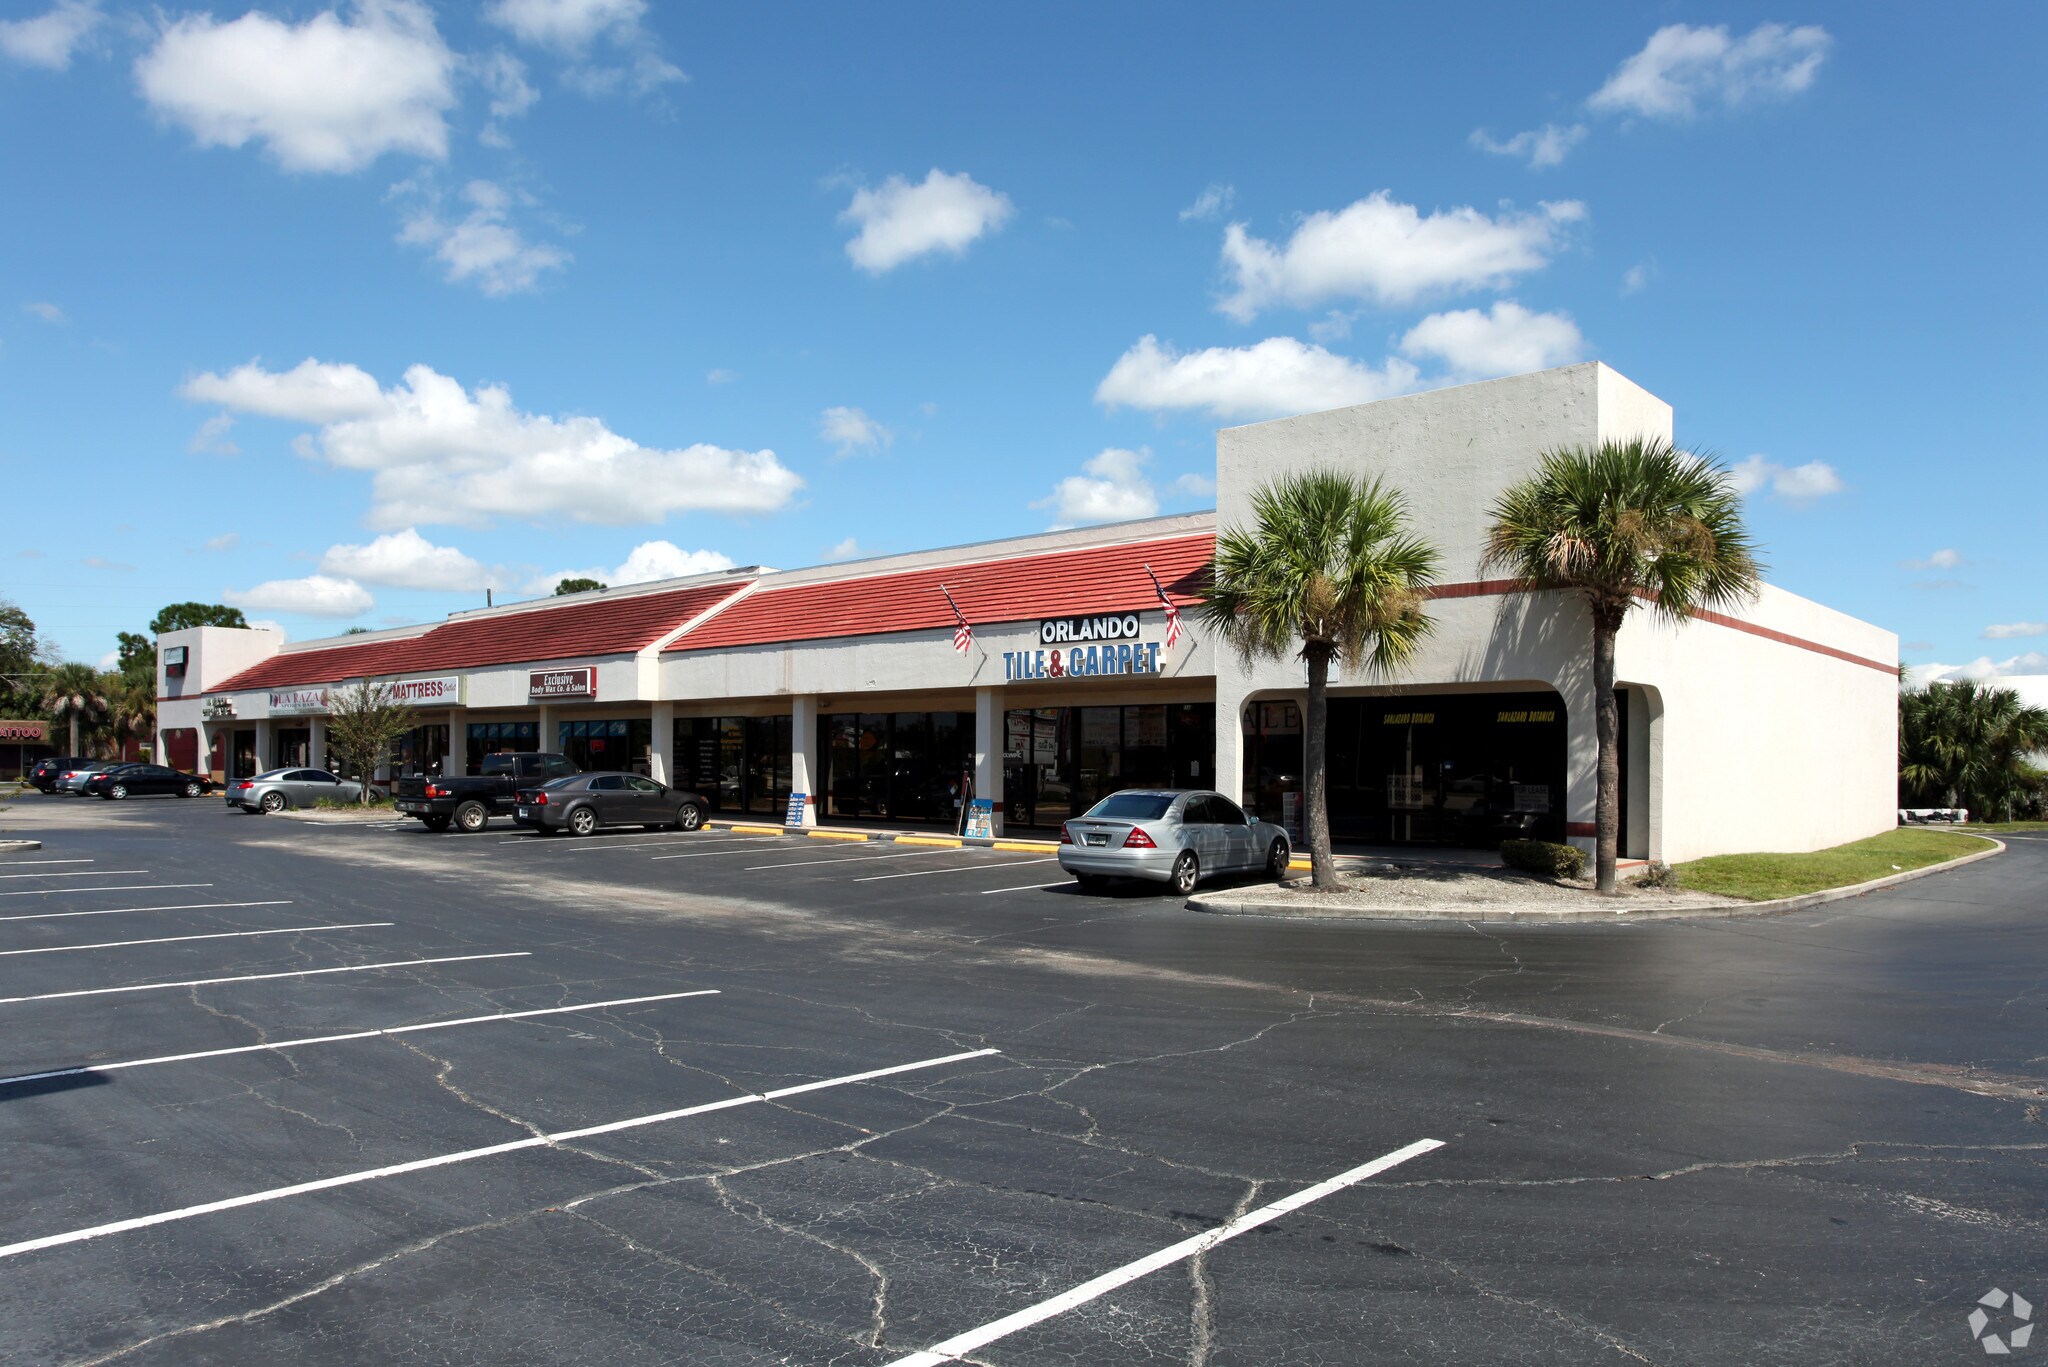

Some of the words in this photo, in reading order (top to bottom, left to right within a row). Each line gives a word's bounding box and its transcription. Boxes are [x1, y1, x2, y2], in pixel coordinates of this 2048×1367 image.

[1042, 615, 1139, 643] ORLANDO
[1002, 650, 1046, 680] TILE
[1049, 649, 1065, 678] &
[1069, 642, 1162, 677] CARPET
[544, 673, 574, 686] Exclusive
[393, 681, 443, 700] MATTRESS
[531, 686, 544, 695] Body
[556, 685, 565, 693] Co.
[566, 684, 571, 692] &
[571, 683, 586, 692] Salon
[278, 693, 291, 704] LA
[294, 691, 320, 703] RAZA
